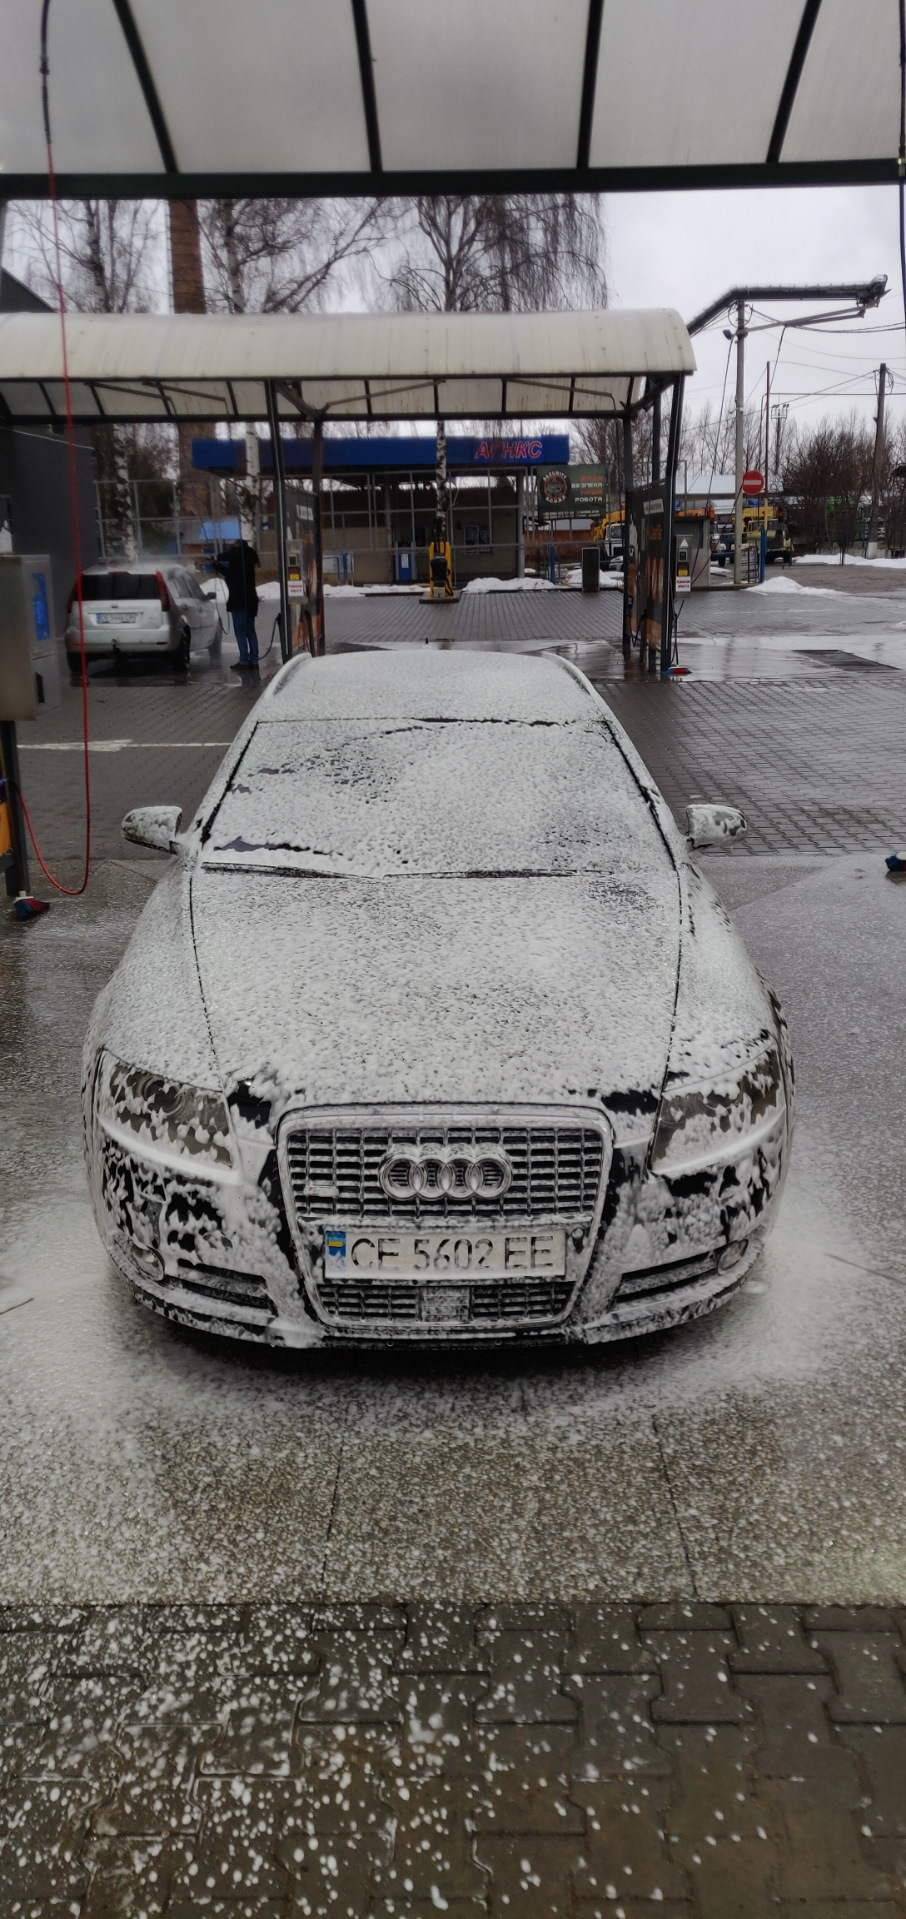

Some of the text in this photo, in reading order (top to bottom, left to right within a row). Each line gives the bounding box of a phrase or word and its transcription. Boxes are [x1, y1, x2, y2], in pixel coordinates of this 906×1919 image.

[474, 440, 543, 459] АГНКС
[413, 1238, 494, 1271] 5602
[504, 1235, 554, 1270] EE
